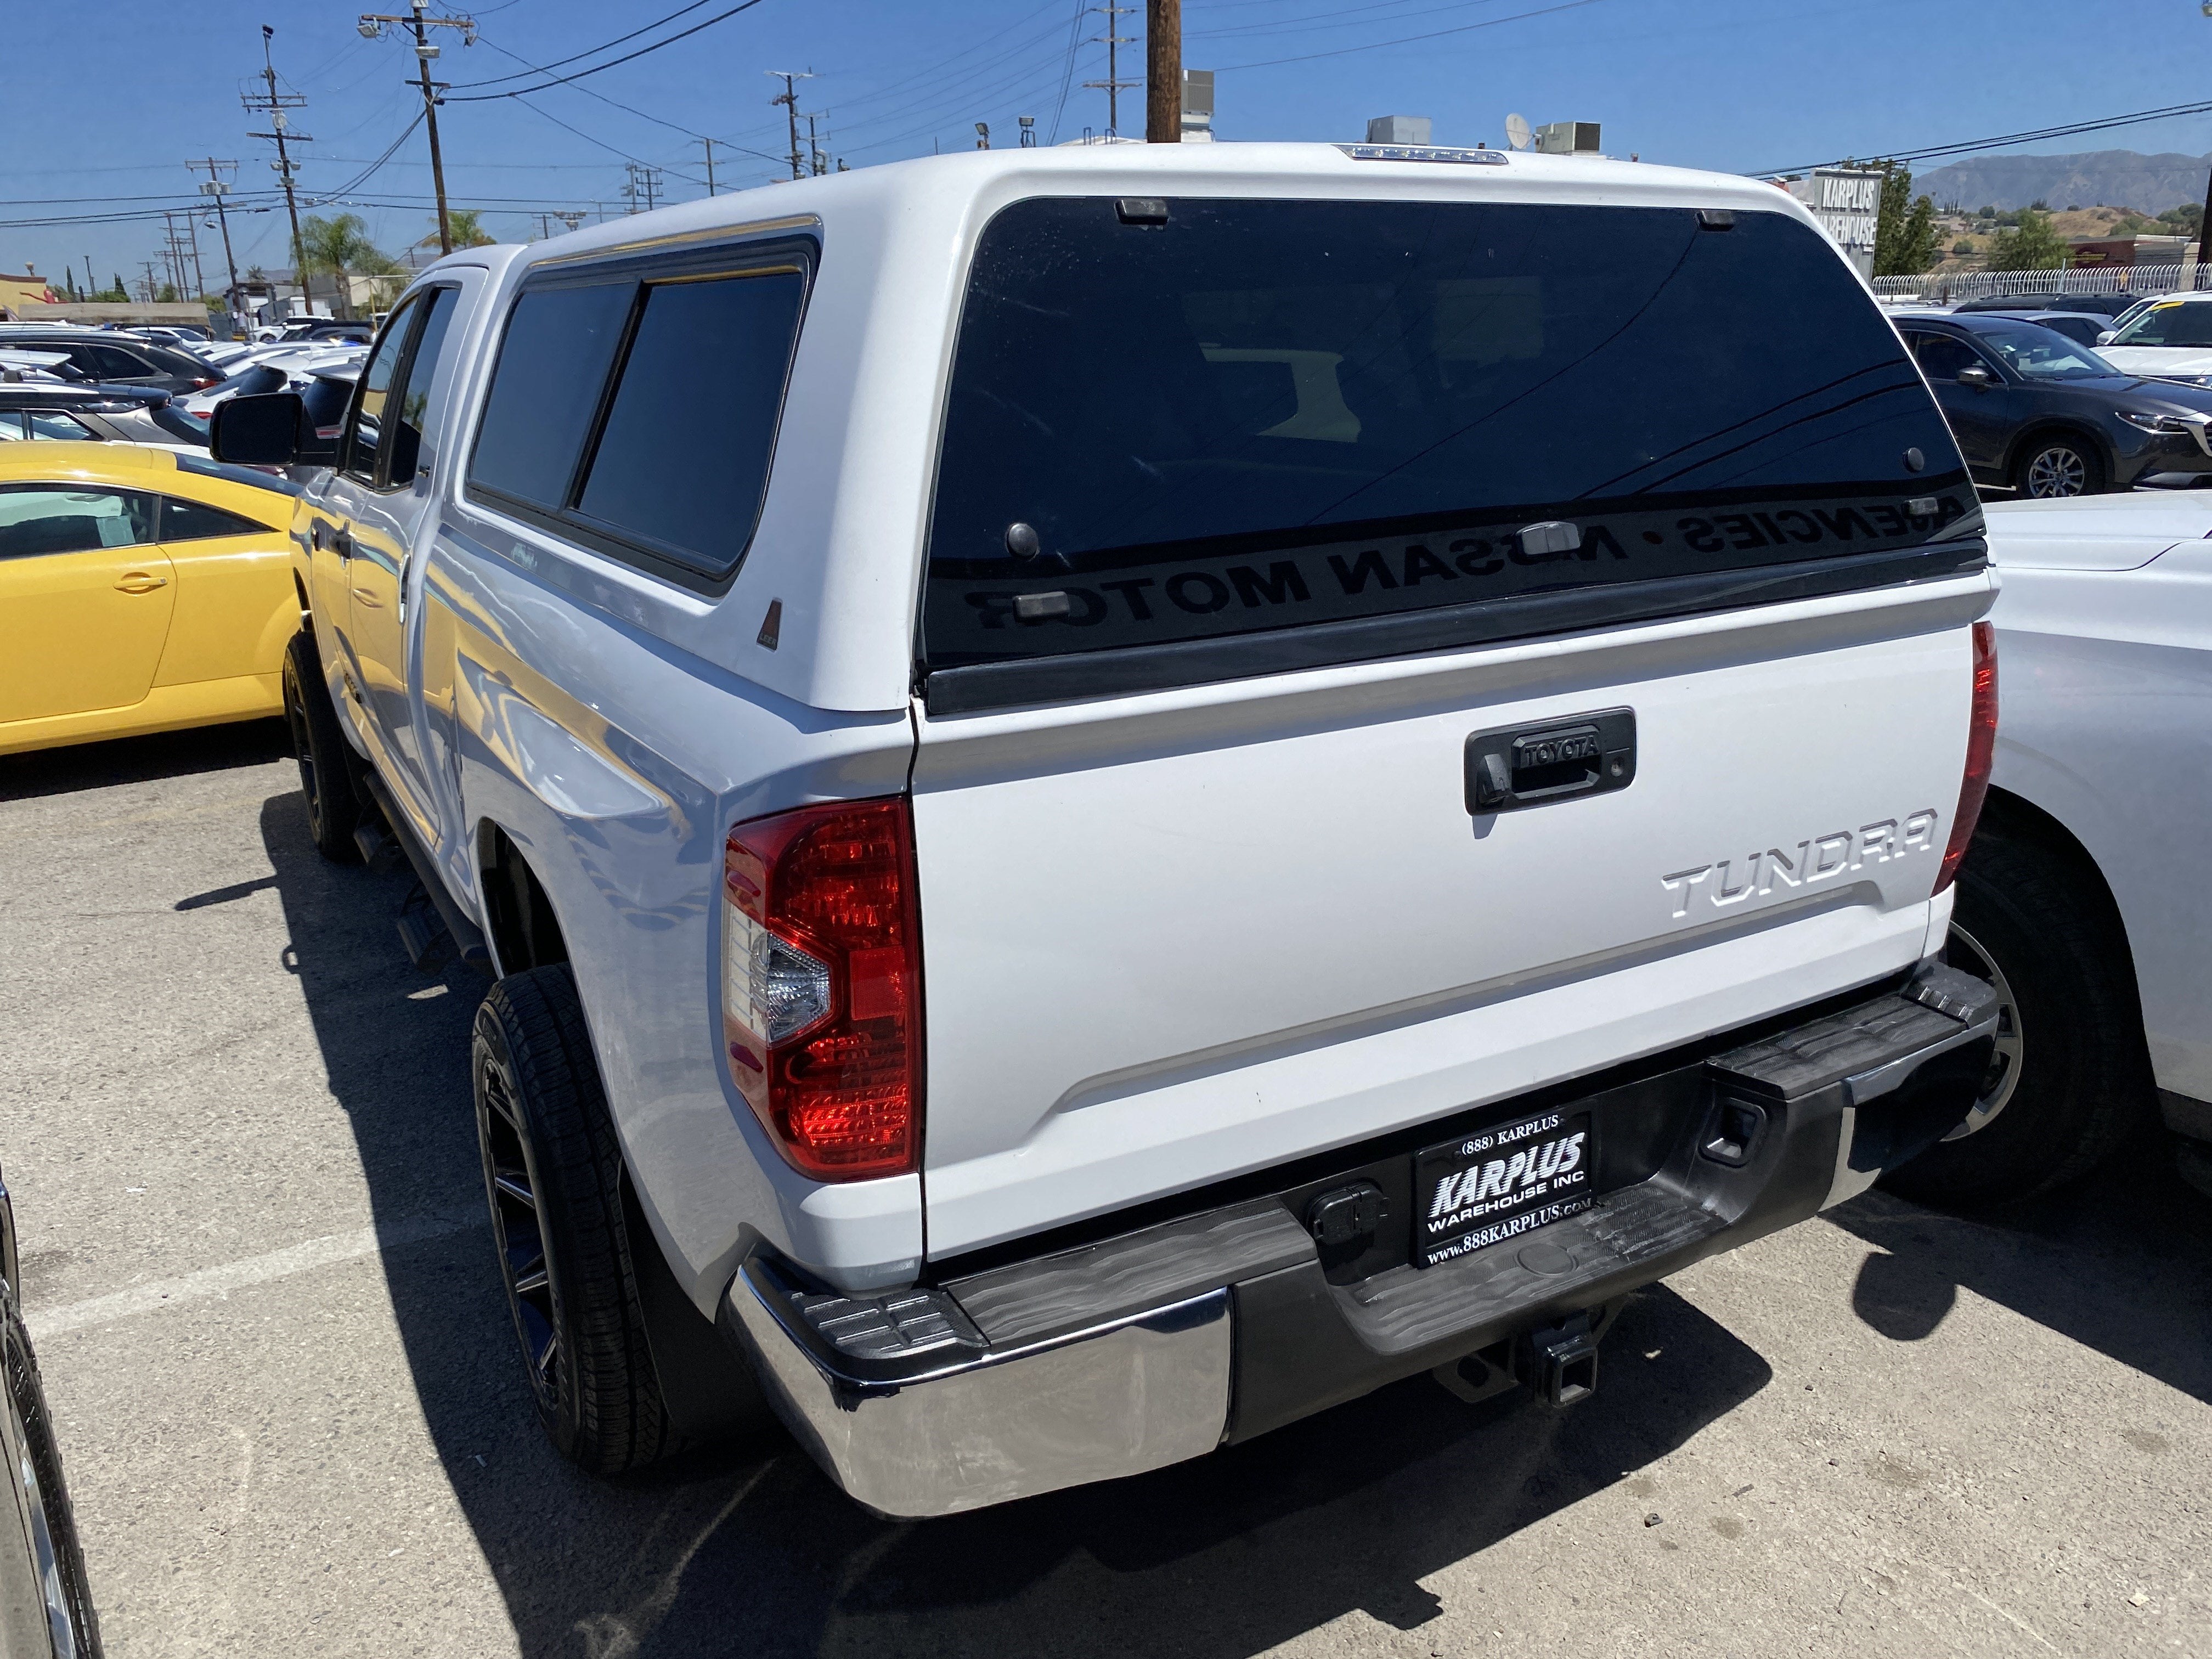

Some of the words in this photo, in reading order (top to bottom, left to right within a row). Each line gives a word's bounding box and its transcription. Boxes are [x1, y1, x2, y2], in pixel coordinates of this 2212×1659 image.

[1822, 178, 1875, 210] KARPLUS
[1815, 215, 1878, 245] AREHOUSE
[1525, 735, 1599, 765] TOYOTA
[1661, 808, 1938, 918] TUNDRA
[1462, 1135, 1494, 1155] (888)
[1497, 1114, 1559, 1146] KARPLUS
[1427, 1131, 1585, 1218] KARPLUS
[1427, 1182, 1547, 1233] WAREHOUSE
[1553, 1170, 1585, 1189] INC
